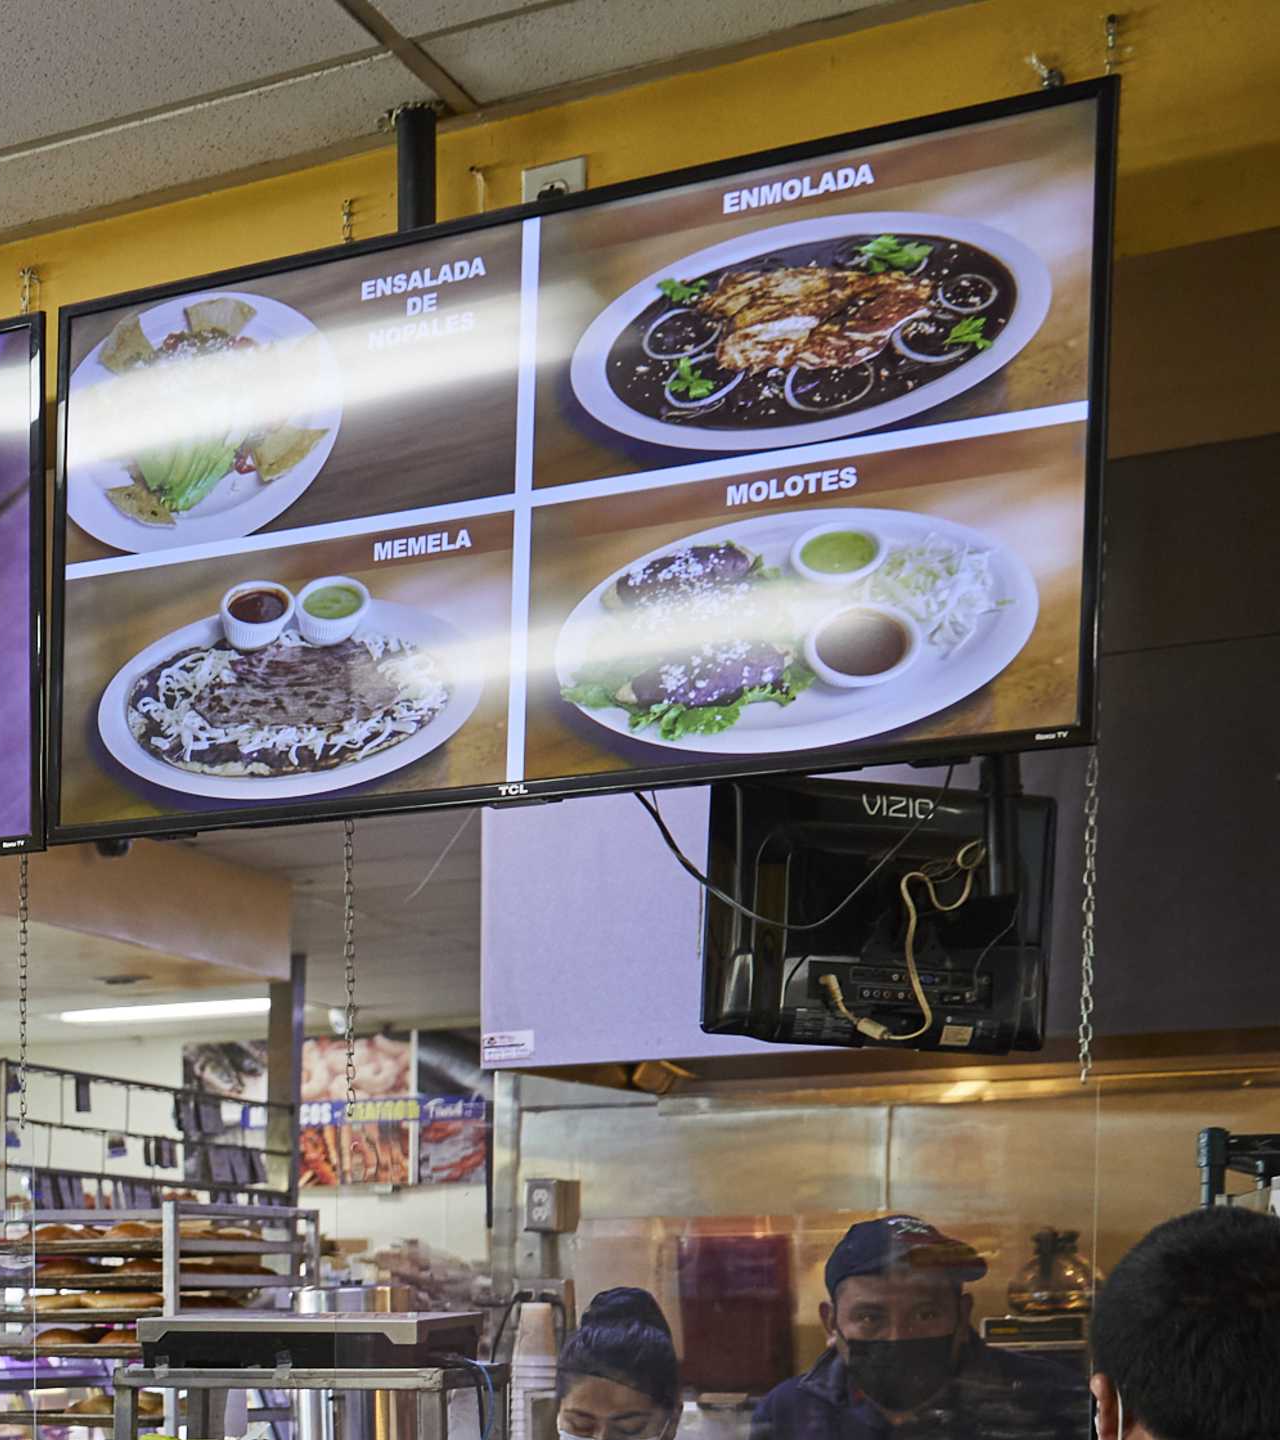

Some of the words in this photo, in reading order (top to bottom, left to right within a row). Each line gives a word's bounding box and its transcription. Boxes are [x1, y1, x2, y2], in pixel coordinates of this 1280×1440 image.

[723, 163, 874, 214] ENMOLADA
[361, 256, 486, 301] ENSALADA
[406, 292, 438, 317] DE
[368, 311, 474, 351] NOPALES
[725, 466, 858, 506] MOLOTES
[373, 529, 472, 561] MEMELA
[498, 784, 528, 796] TCL
[862, 794, 934, 819] VIZIO
